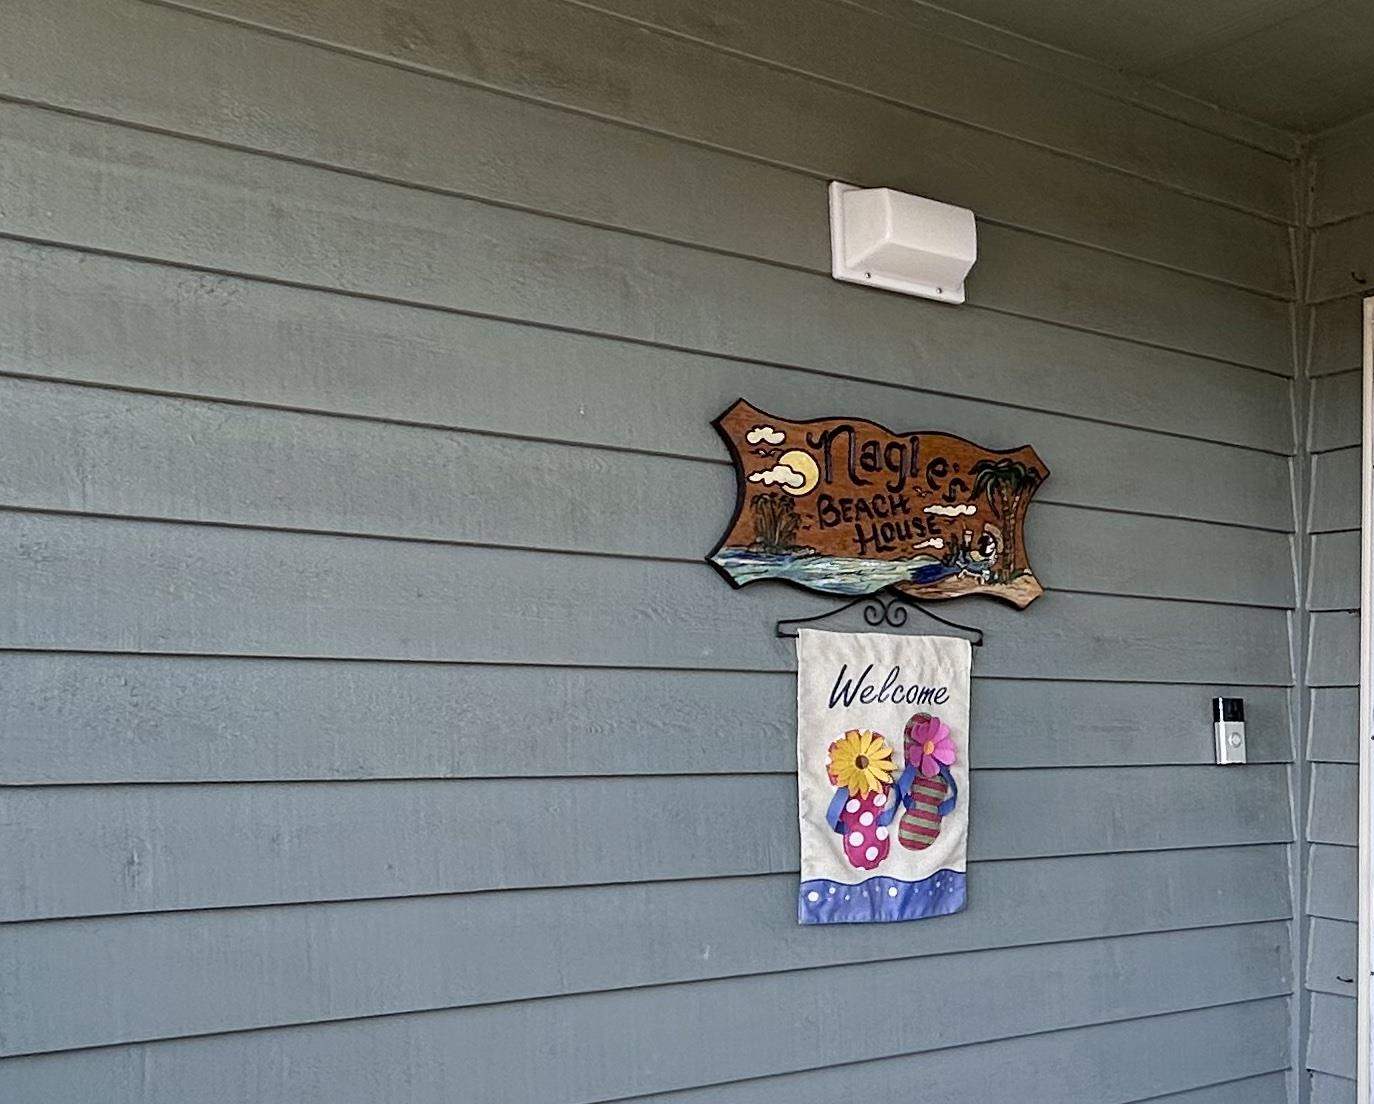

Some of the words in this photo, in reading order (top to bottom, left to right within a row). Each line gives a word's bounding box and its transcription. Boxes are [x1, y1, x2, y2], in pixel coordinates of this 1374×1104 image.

[817, 493, 911, 529] BEACH
[853, 515, 941, 555] HOUSE
[828, 663, 950, 710] Welcome
